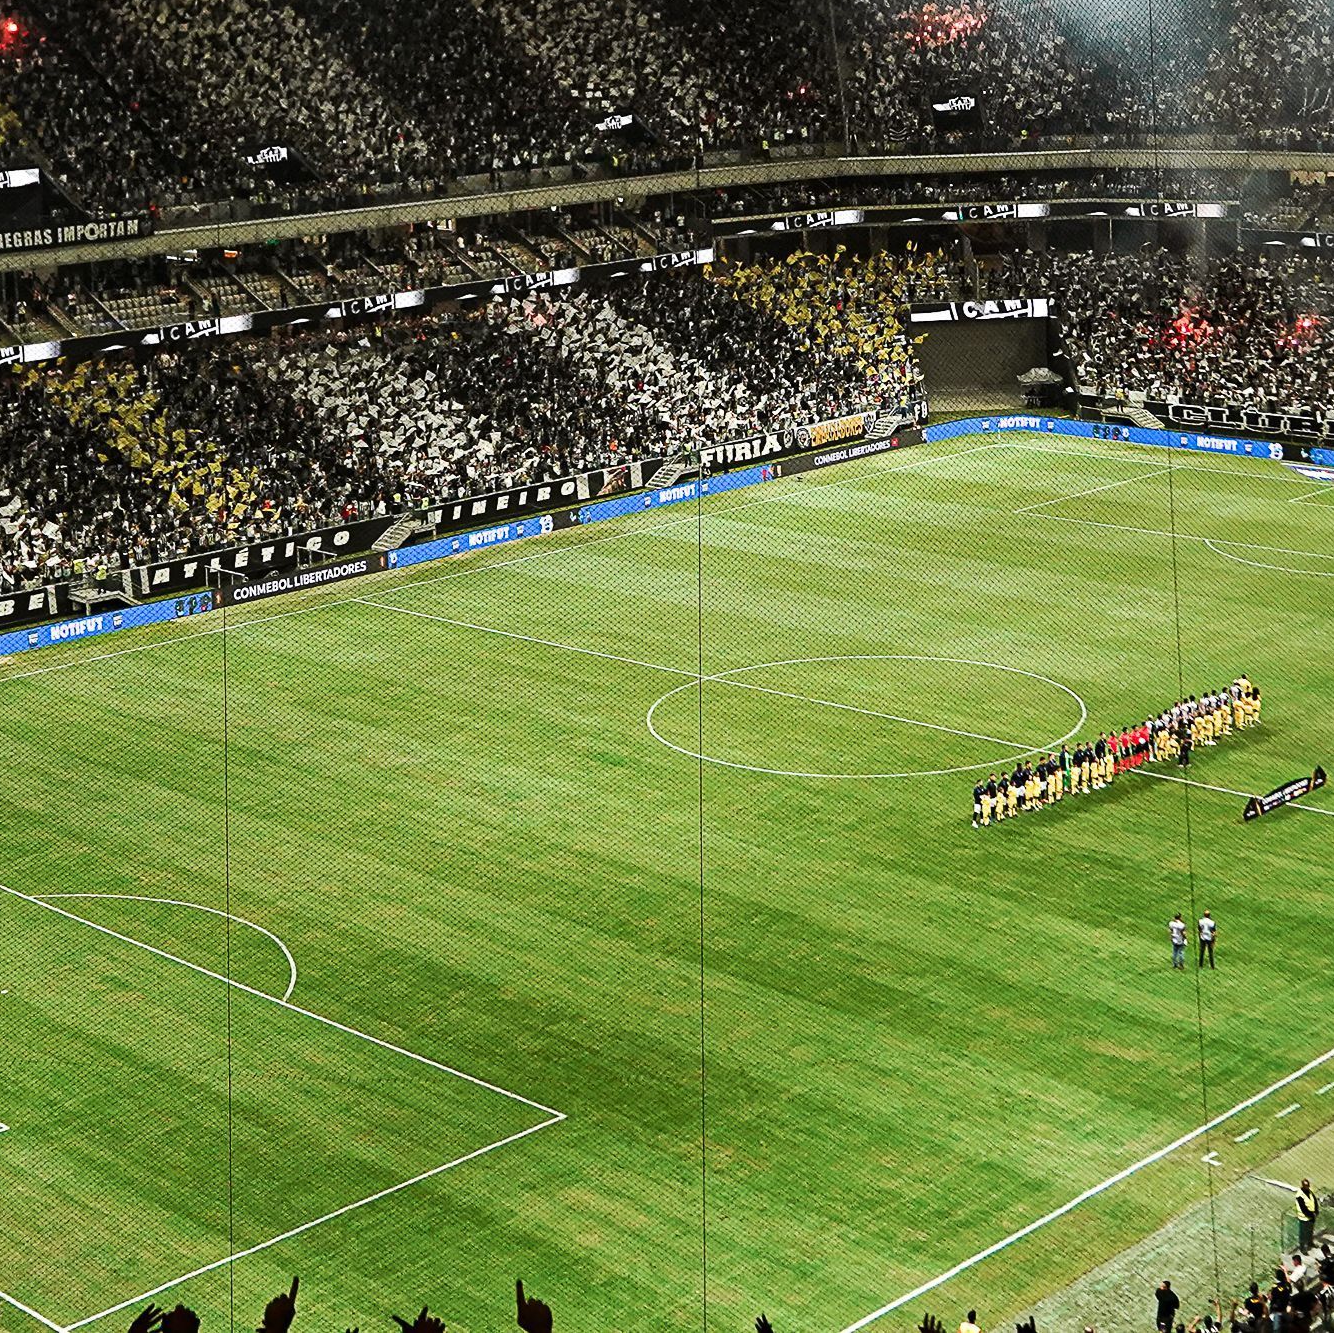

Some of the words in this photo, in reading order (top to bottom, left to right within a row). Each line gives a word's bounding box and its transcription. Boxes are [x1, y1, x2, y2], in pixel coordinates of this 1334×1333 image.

[969, 205, 1009, 219] CAM
[1151, 203, 1189, 216] CAM
[794, 213, 828, 228] CAM
[660, 251, 691, 268] CAM
[513, 272, 548, 290] CAM
[351, 296, 388, 314] CAM
[963, 299, 1022, 318] CAM
[170, 320, 212, 340] CAM
[814, 452, 848, 467] CONMEBOL
[848, 440, 891, 459] LIBERTADORES
[233, 577, 294, 601] CONMEBOL
[294, 561, 367, 587] LIBERTADORES
[50, 617, 104, 641] NOTIFUT
